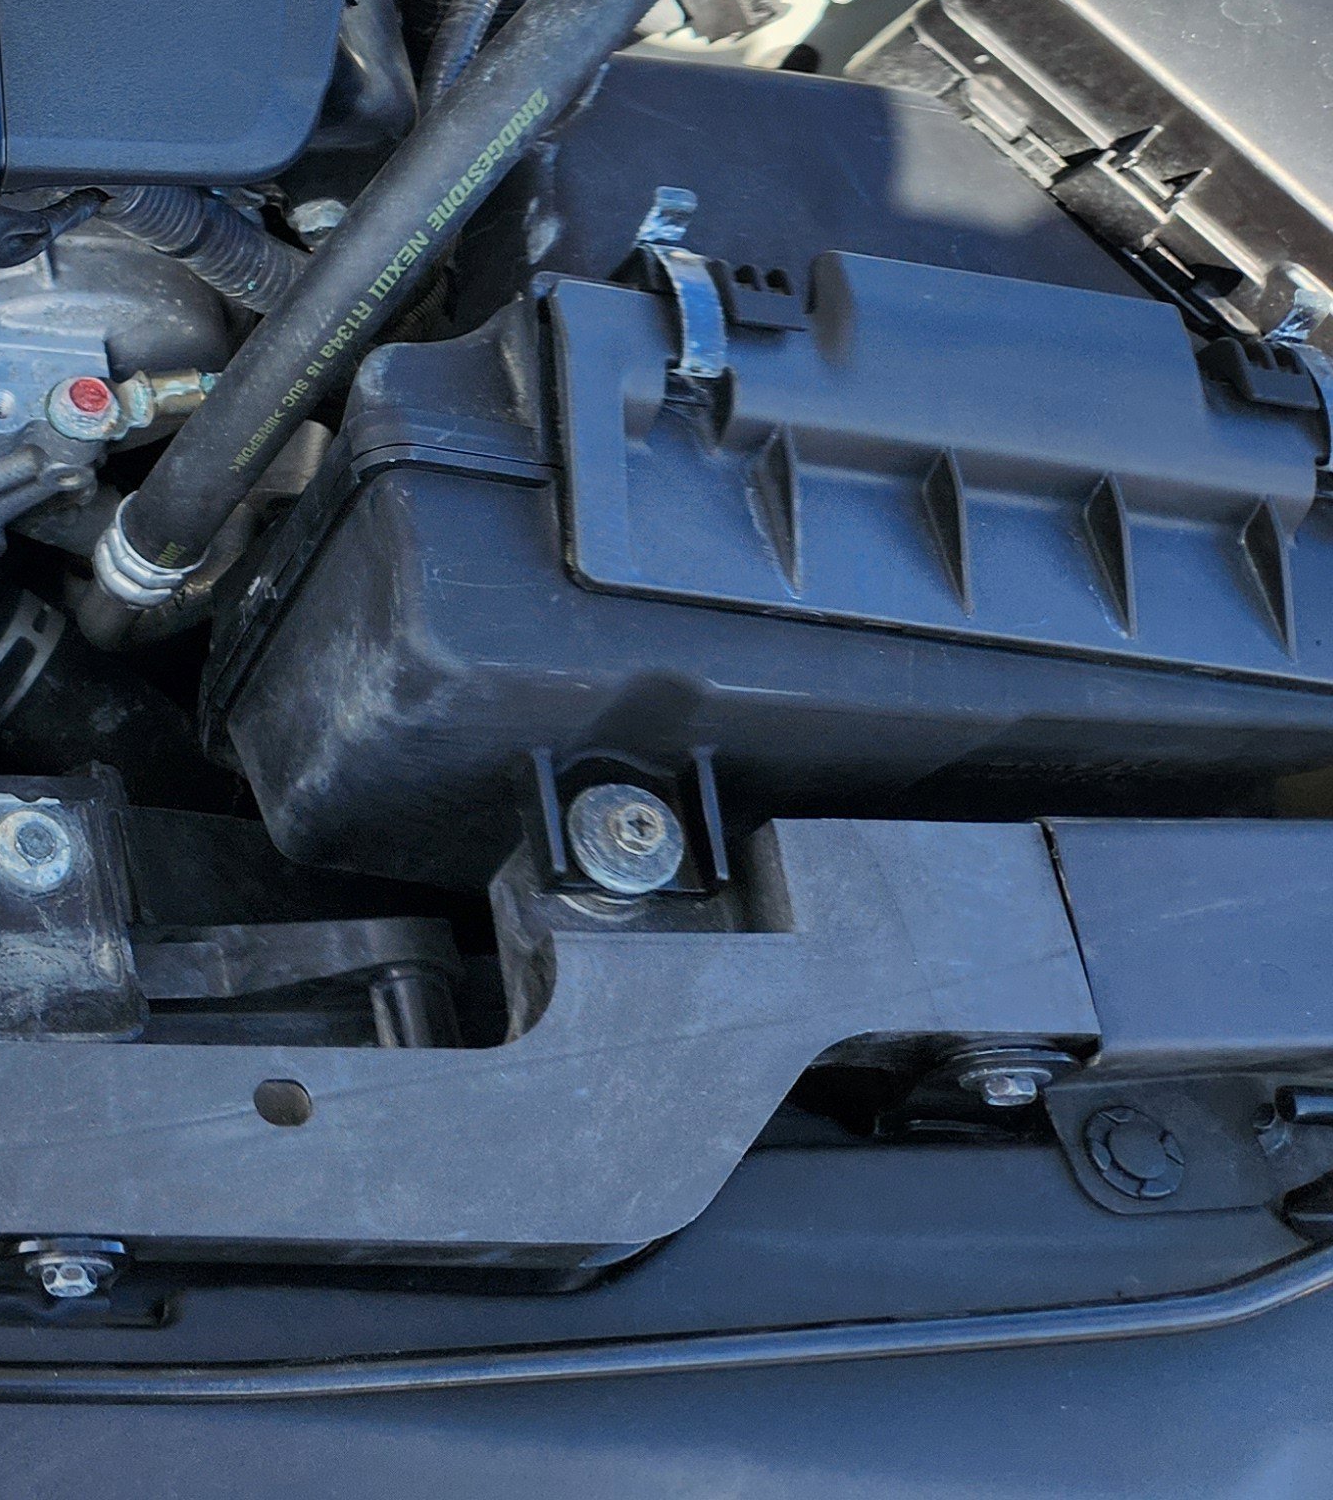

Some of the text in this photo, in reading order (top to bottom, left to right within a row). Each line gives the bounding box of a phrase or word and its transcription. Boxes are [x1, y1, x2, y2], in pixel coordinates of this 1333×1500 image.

[428, 87, 550, 232] BRIDGESTONE
[317, 299, 375, 363] R134a
[280, 377, 310, 410] SUC
